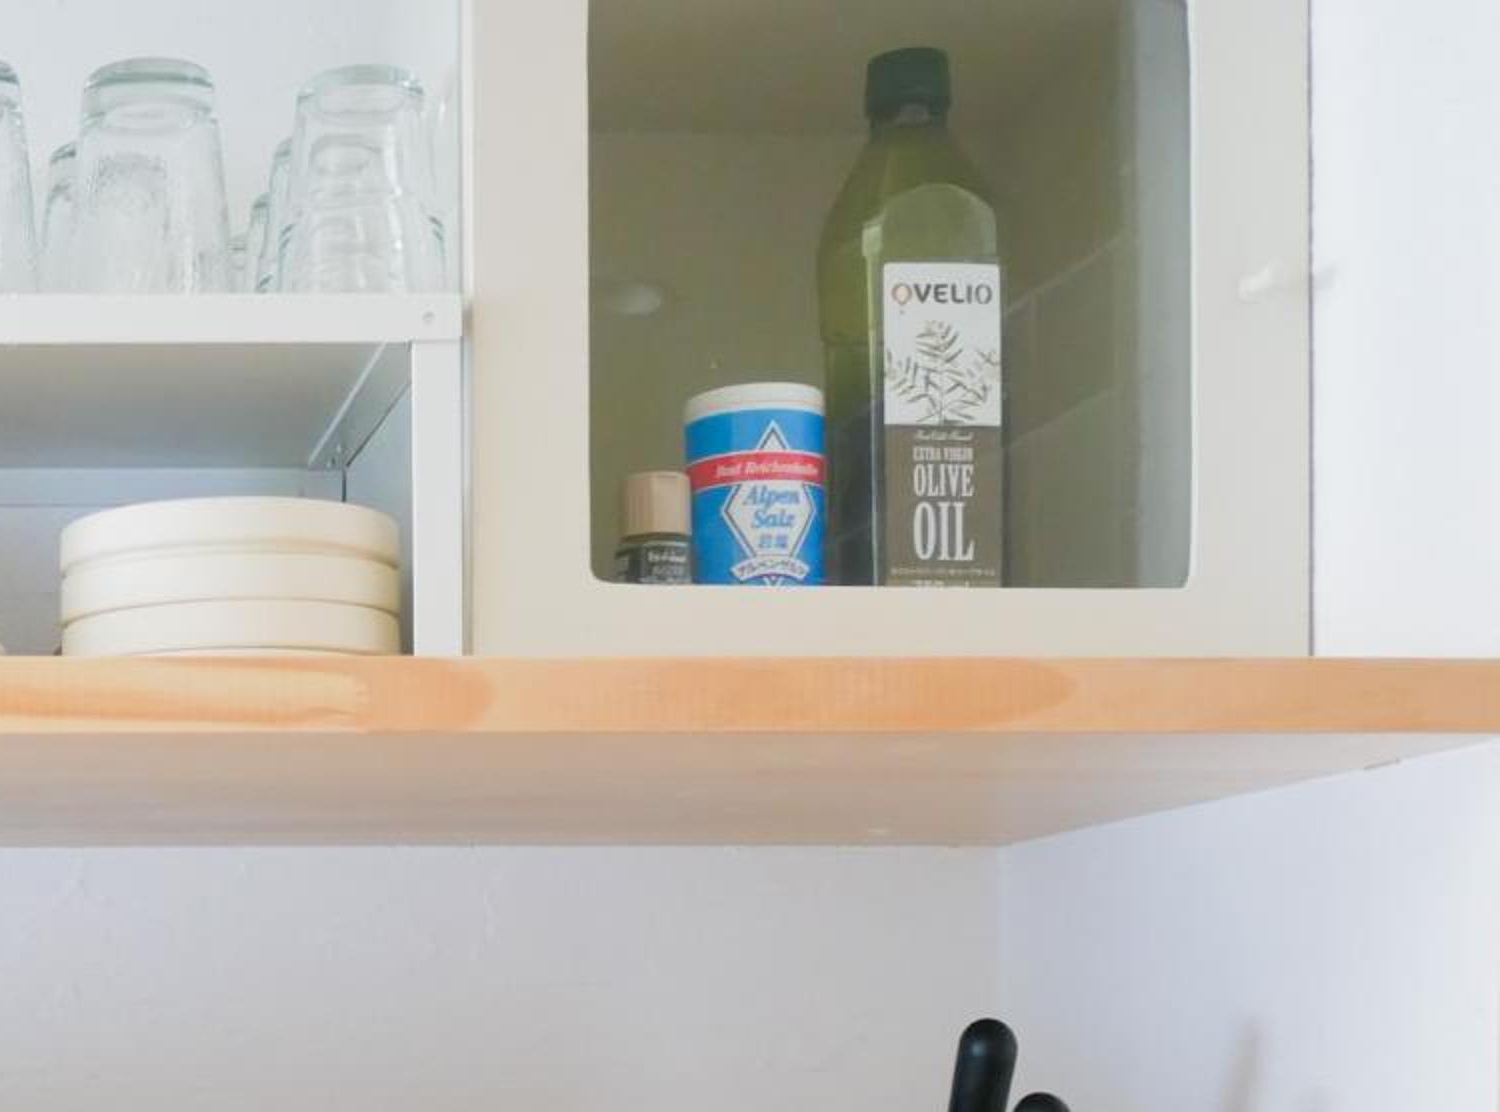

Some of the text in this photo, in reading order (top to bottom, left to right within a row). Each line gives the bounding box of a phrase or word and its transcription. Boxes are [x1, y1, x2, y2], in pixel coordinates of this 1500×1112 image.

[891, 283, 993, 305] OVELIO
[913, 447, 974, 461] EXTRA VIRGIN
[913, 463, 975, 497] OLIVE
[742, 484, 801, 512] Alpen
[913, 501, 975, 561] OIL
